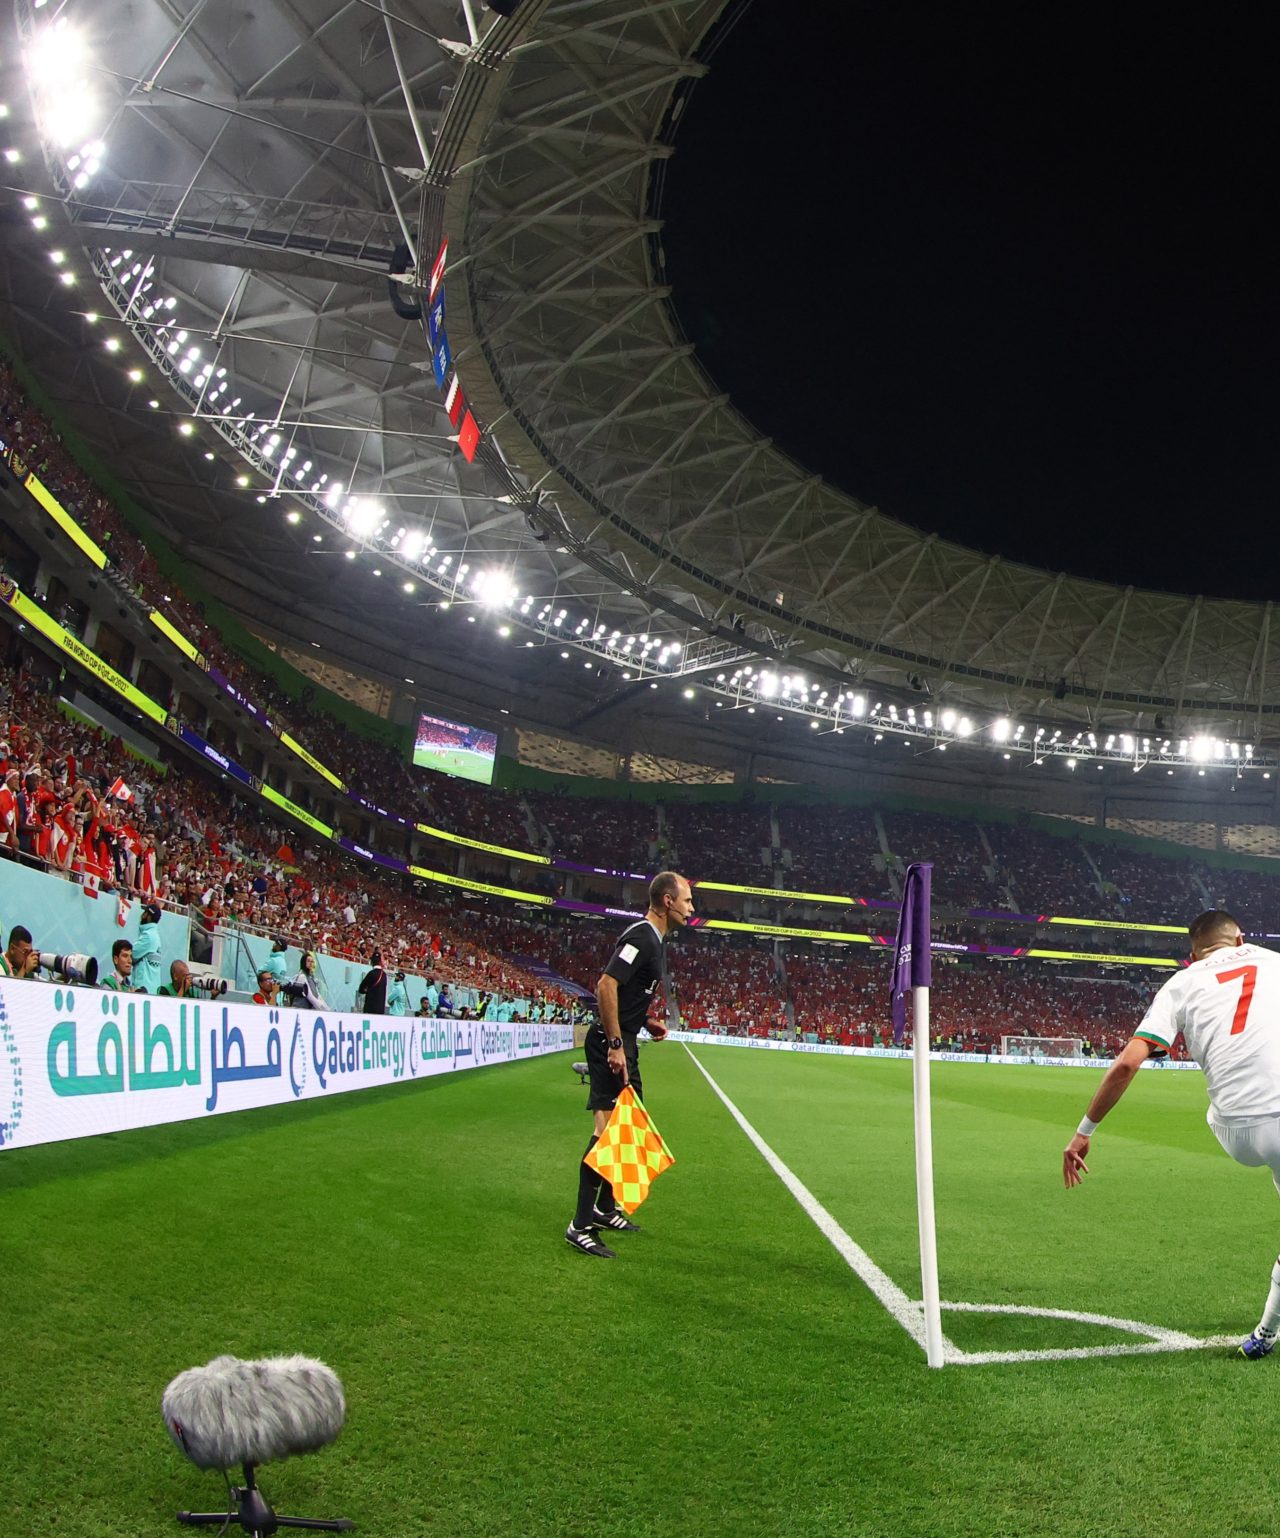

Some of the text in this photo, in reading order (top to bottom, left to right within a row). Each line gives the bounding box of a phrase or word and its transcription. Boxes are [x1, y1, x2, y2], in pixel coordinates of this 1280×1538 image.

[63, 635, 73, 649] FIFA
[73, 645, 90, 662] WORLD
[89, 657, 98, 669] CUP
[1215, 965, 1257, 1036] 7
[47, 988, 282, 1112] قطر للطاقة
[312, 1016, 406, 1090] QatarEnergy
[421, 1020, 453, 1060] للطاقة
[481, 1023, 513, 1062] QatarEnergy
[791, 1042, 845, 1055] QatarEnergy
